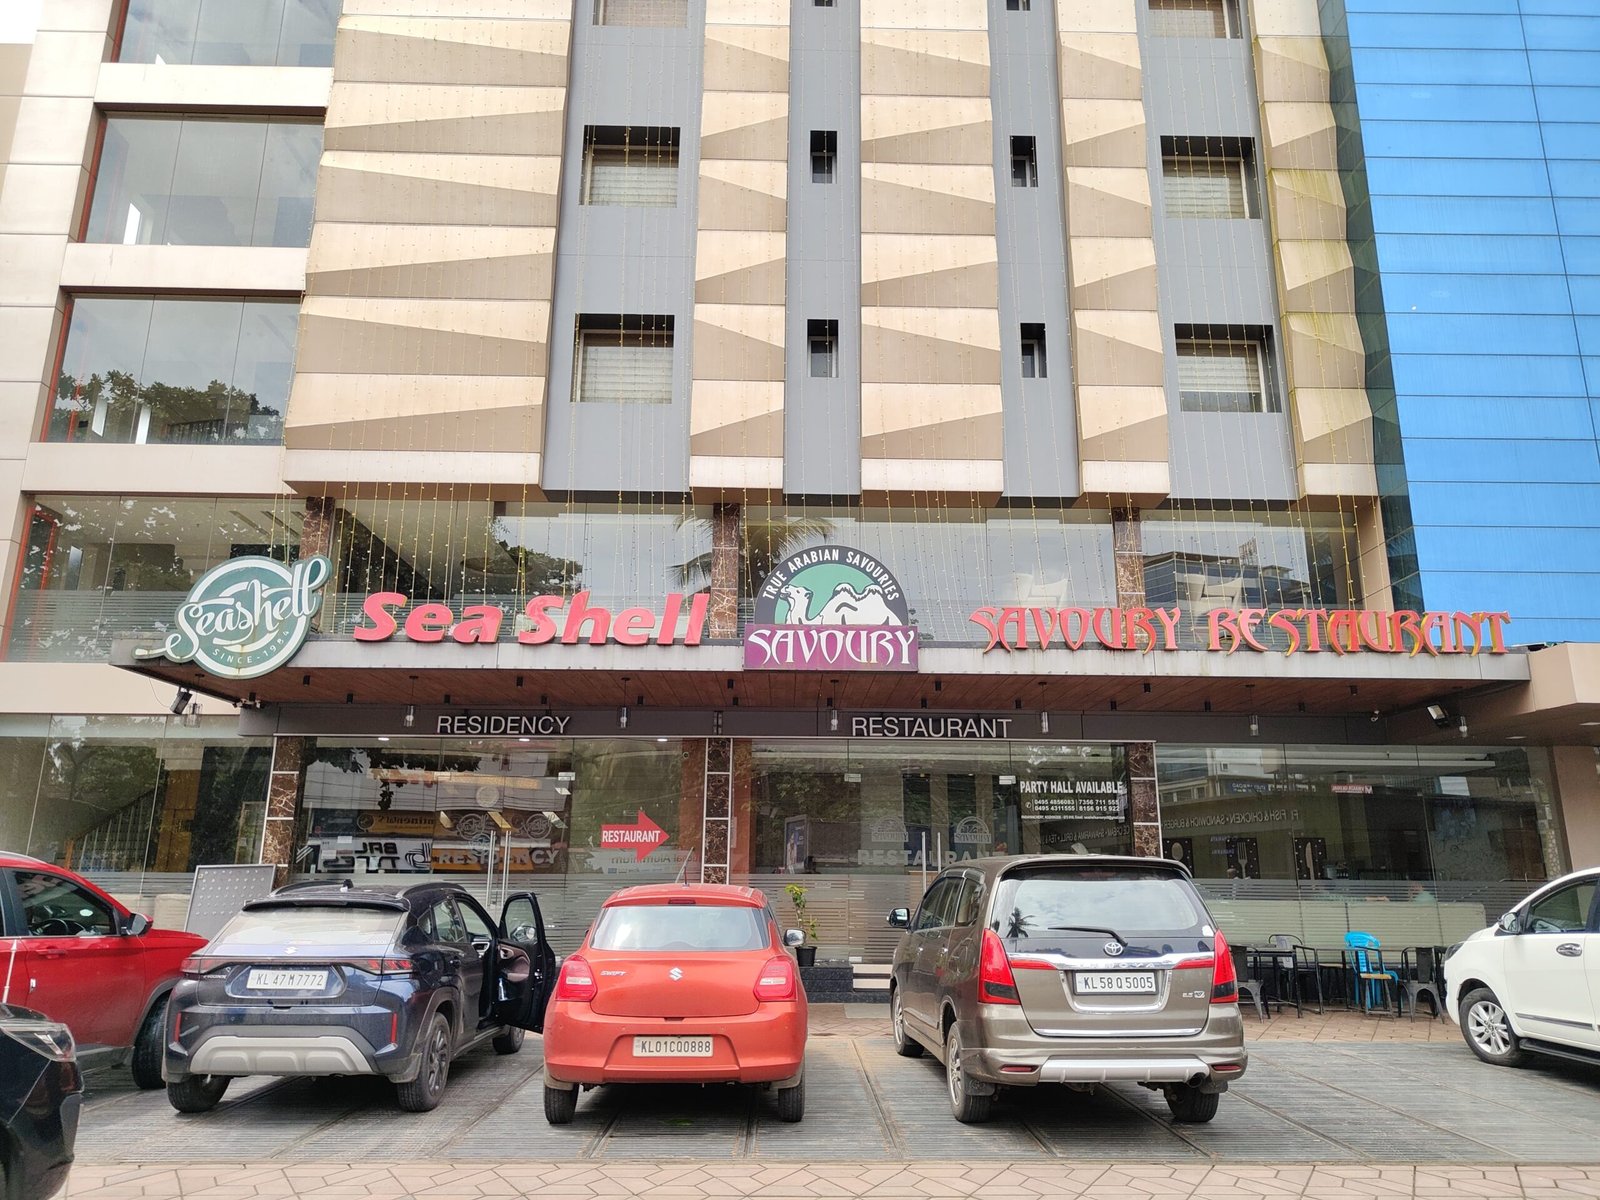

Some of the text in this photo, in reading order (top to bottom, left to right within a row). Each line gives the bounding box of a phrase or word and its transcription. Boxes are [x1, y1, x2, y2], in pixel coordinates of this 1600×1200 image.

[762, 549, 900, 601] TRUE ARABIAN SAVOURIES
[134, 556, 329, 659] Seashell
[353, 590, 711, 645] Sea Shell
[969, 606, 1511, 657] SAVOURY RESTAURANT
[748, 629, 915, 665] SAVOURY
[437, 715, 571, 735] RESIDENCY
[852, 717, 1012, 738] RESTAURANT
[1020, 781, 1123, 794] PARTY HALL AVAILABLE
[601, 830, 661, 843] RESTAURANT
[256, 973, 269, 986] KL
[1083, 976, 1098, 989] KL
[1100, 976, 1113, 989] 58
[1125, 976, 1153, 989] 5005
[641, 1040, 711, 1053] KL01CQ0888
